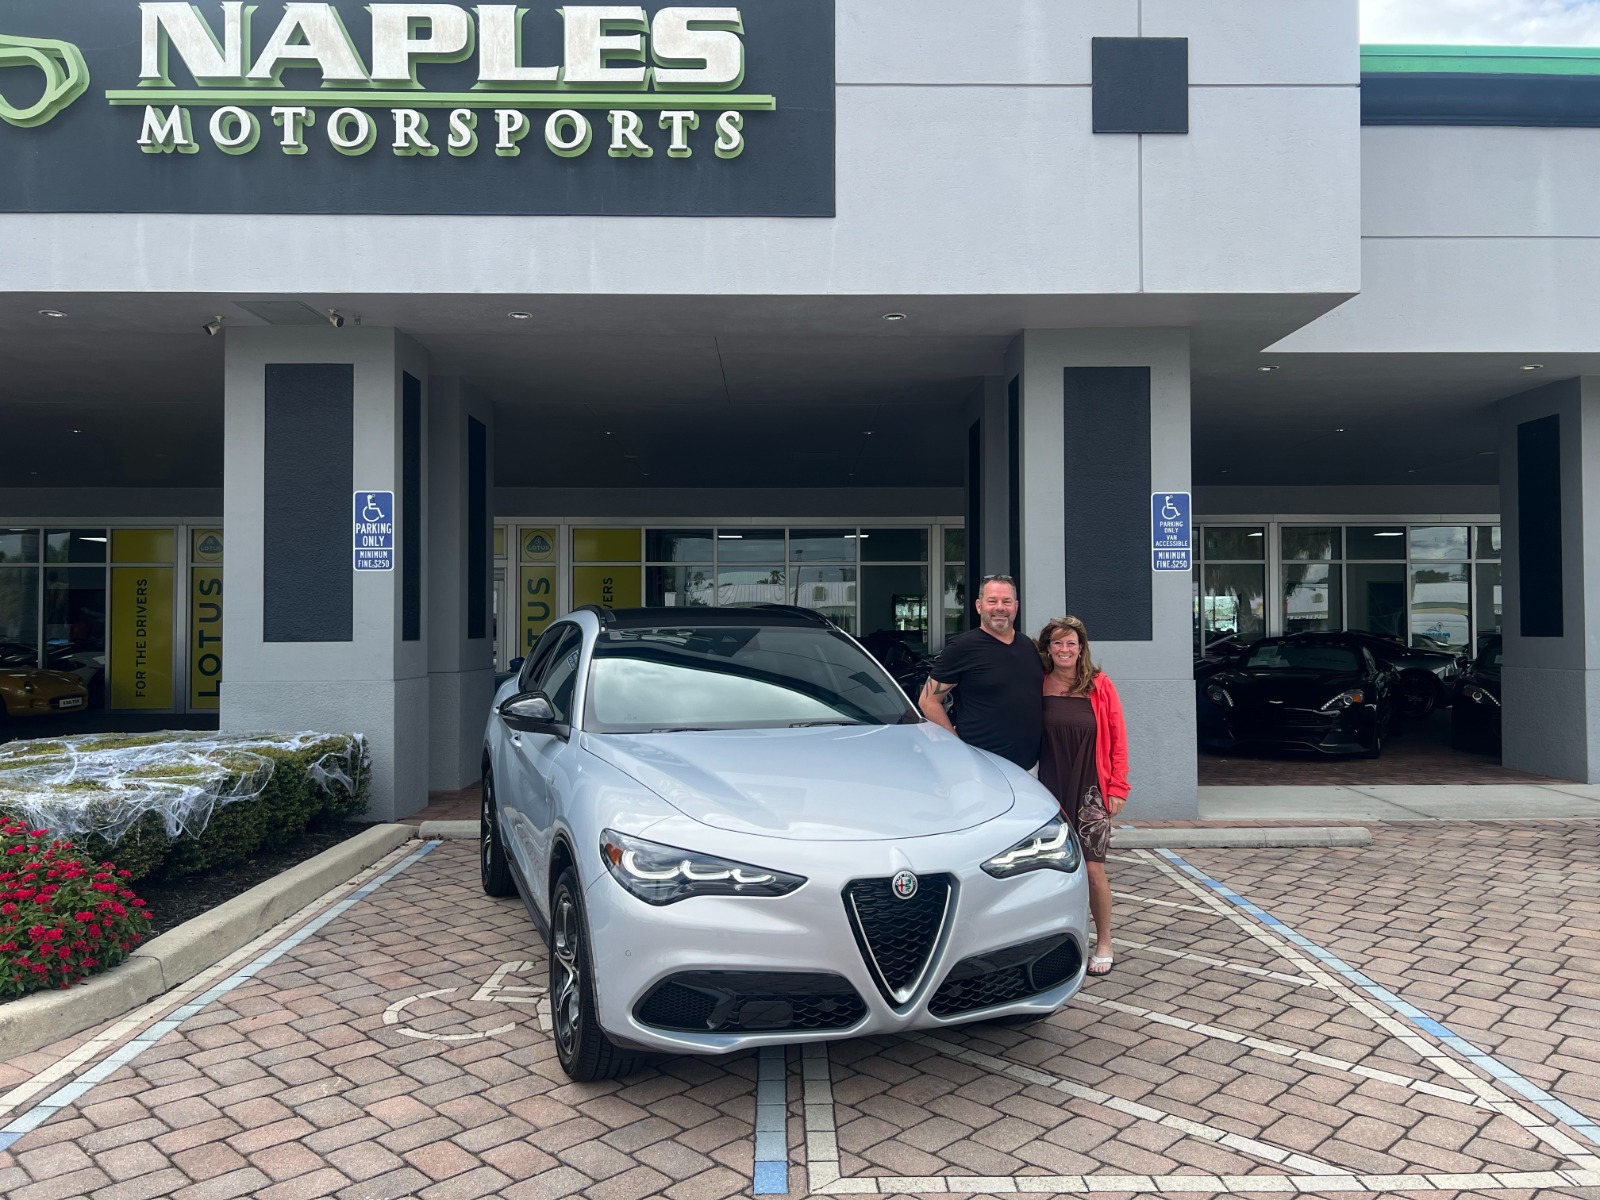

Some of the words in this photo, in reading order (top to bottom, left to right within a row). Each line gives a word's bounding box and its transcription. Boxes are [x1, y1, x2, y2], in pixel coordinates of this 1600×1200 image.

[137, 1, 744, 88] NAPLES
[137, 104, 744, 155] MOTORSPORTS
[355, 523, 392, 534] PARKING
[362, 535, 385, 547] ONLY
[357, 559, 373, 568] FINE
[374, 559, 390, 568] $250
[359, 551, 388, 559] MINIMUM
[1156, 560, 1171, 568] FINE
[1172, 560, 1188, 568] $250
[1158, 551, 1186, 560] MINIMUM
[136, 579, 148, 637] DRIVERS
[527, 577, 551, 648] TUS
[198, 578, 223, 697] LOTUS
[136, 640, 147, 667] THE
[136, 671, 146, 697] FOR
